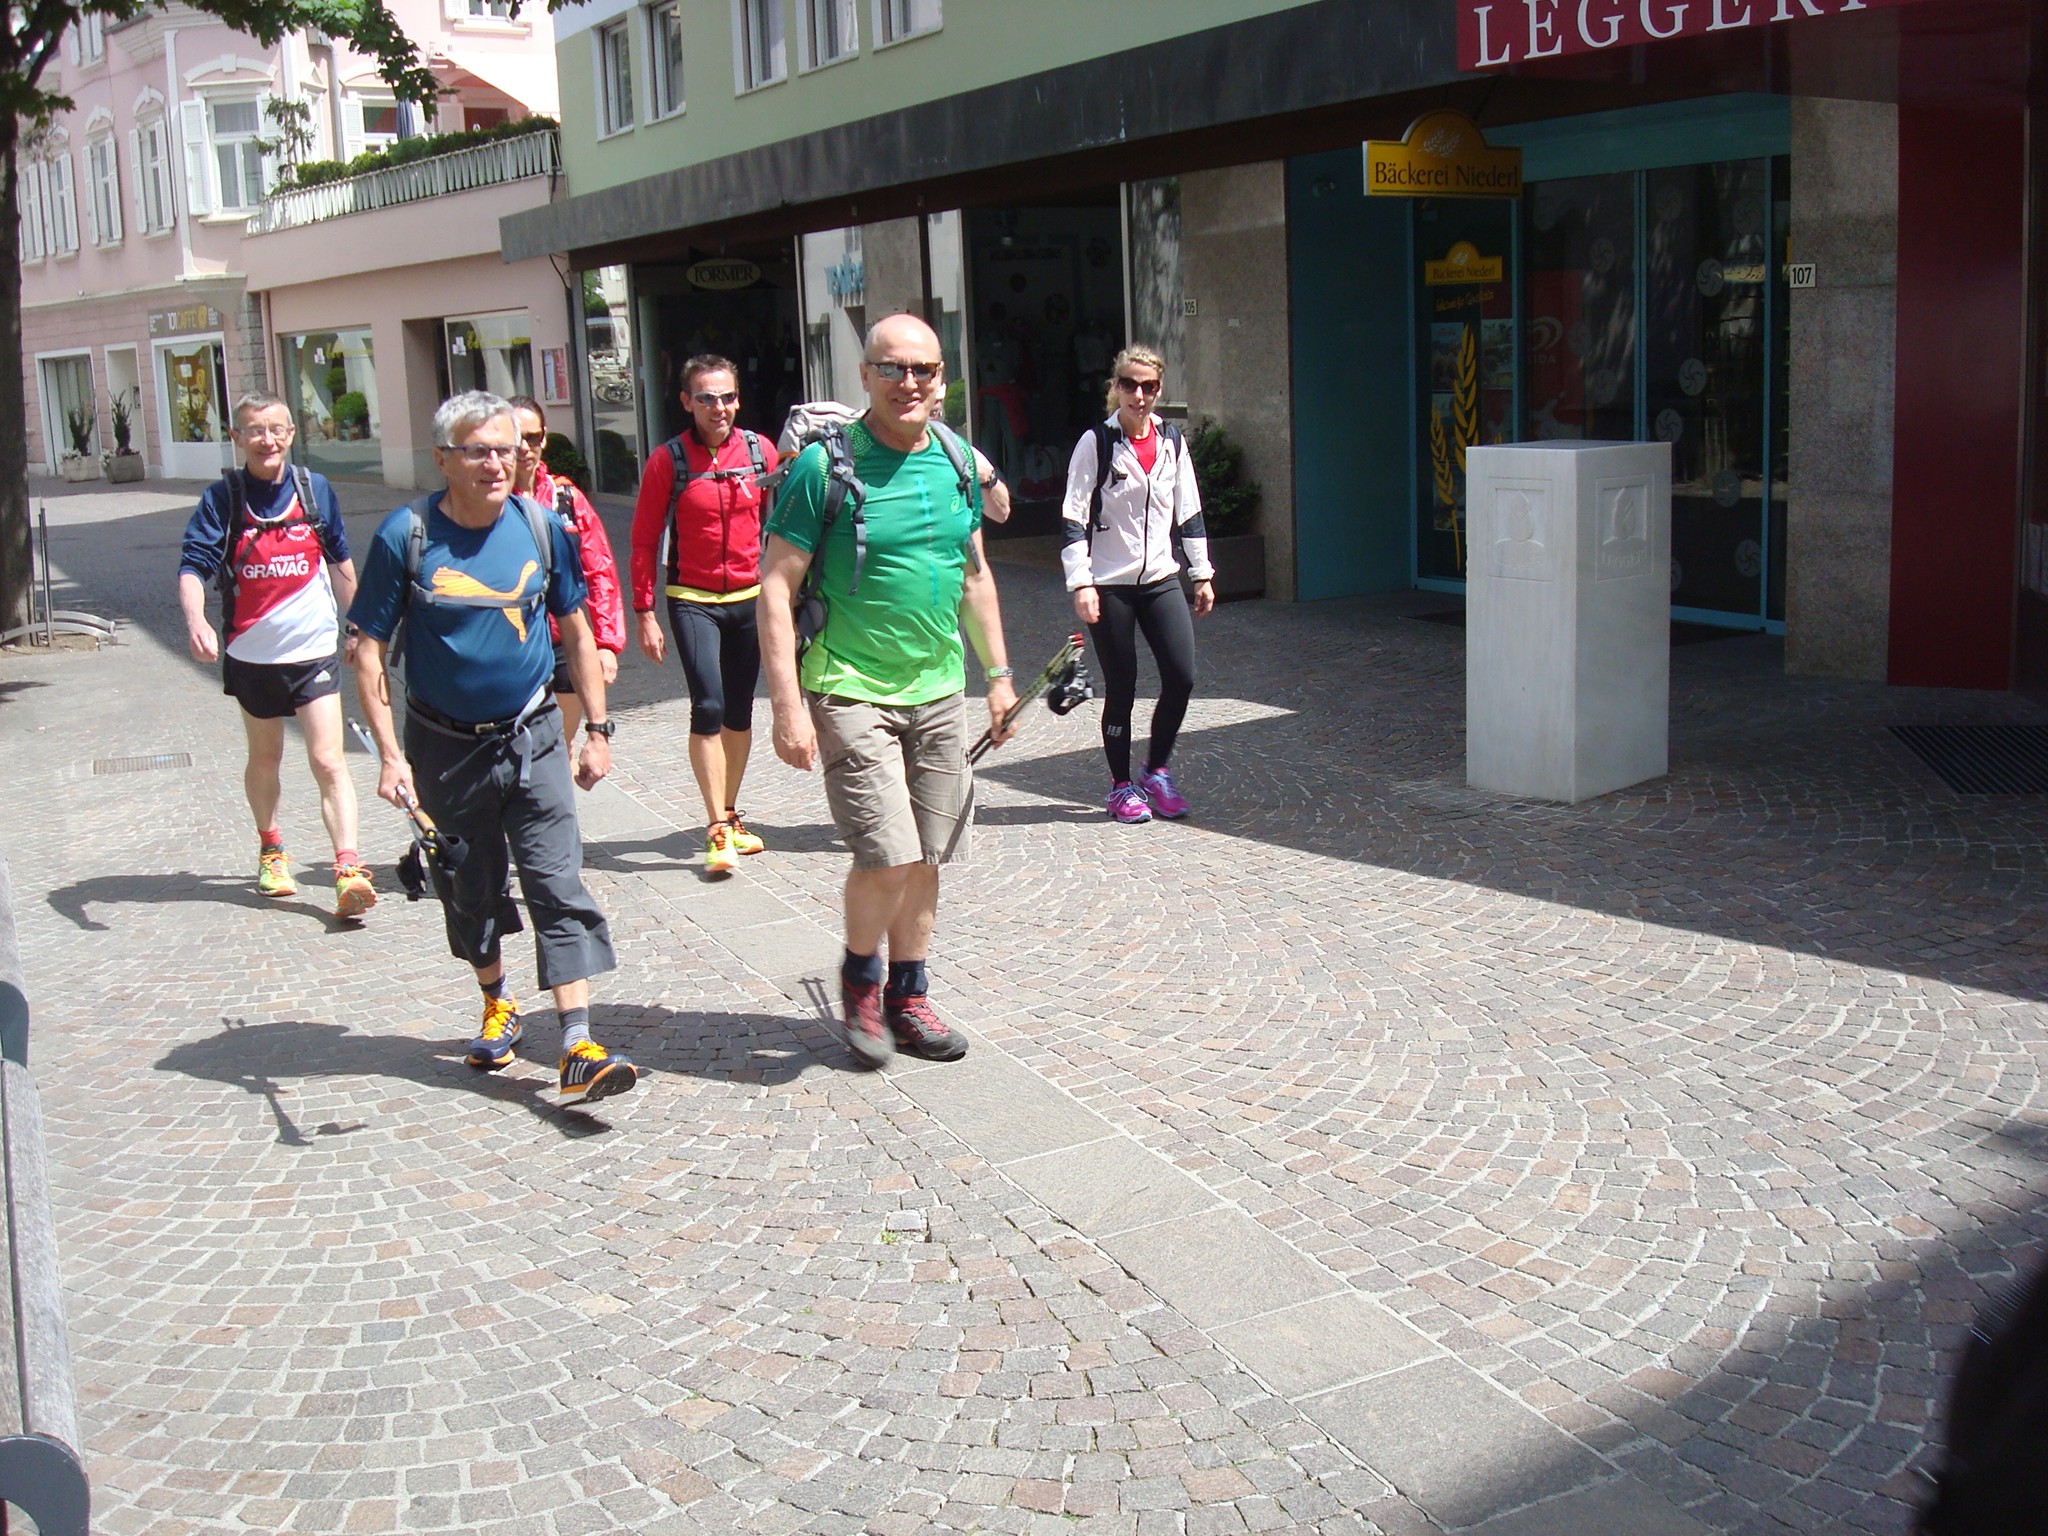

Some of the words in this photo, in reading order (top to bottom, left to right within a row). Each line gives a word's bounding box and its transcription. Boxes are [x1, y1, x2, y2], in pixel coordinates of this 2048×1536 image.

[1375, 161, 1449, 185] Bäckerei
[1456, 165, 1519, 188] Niederl
[694, 264, 754, 283] FORMER
[1792, 267, 1812, 284] 107
[242, 560, 309, 579] GRAVAG
